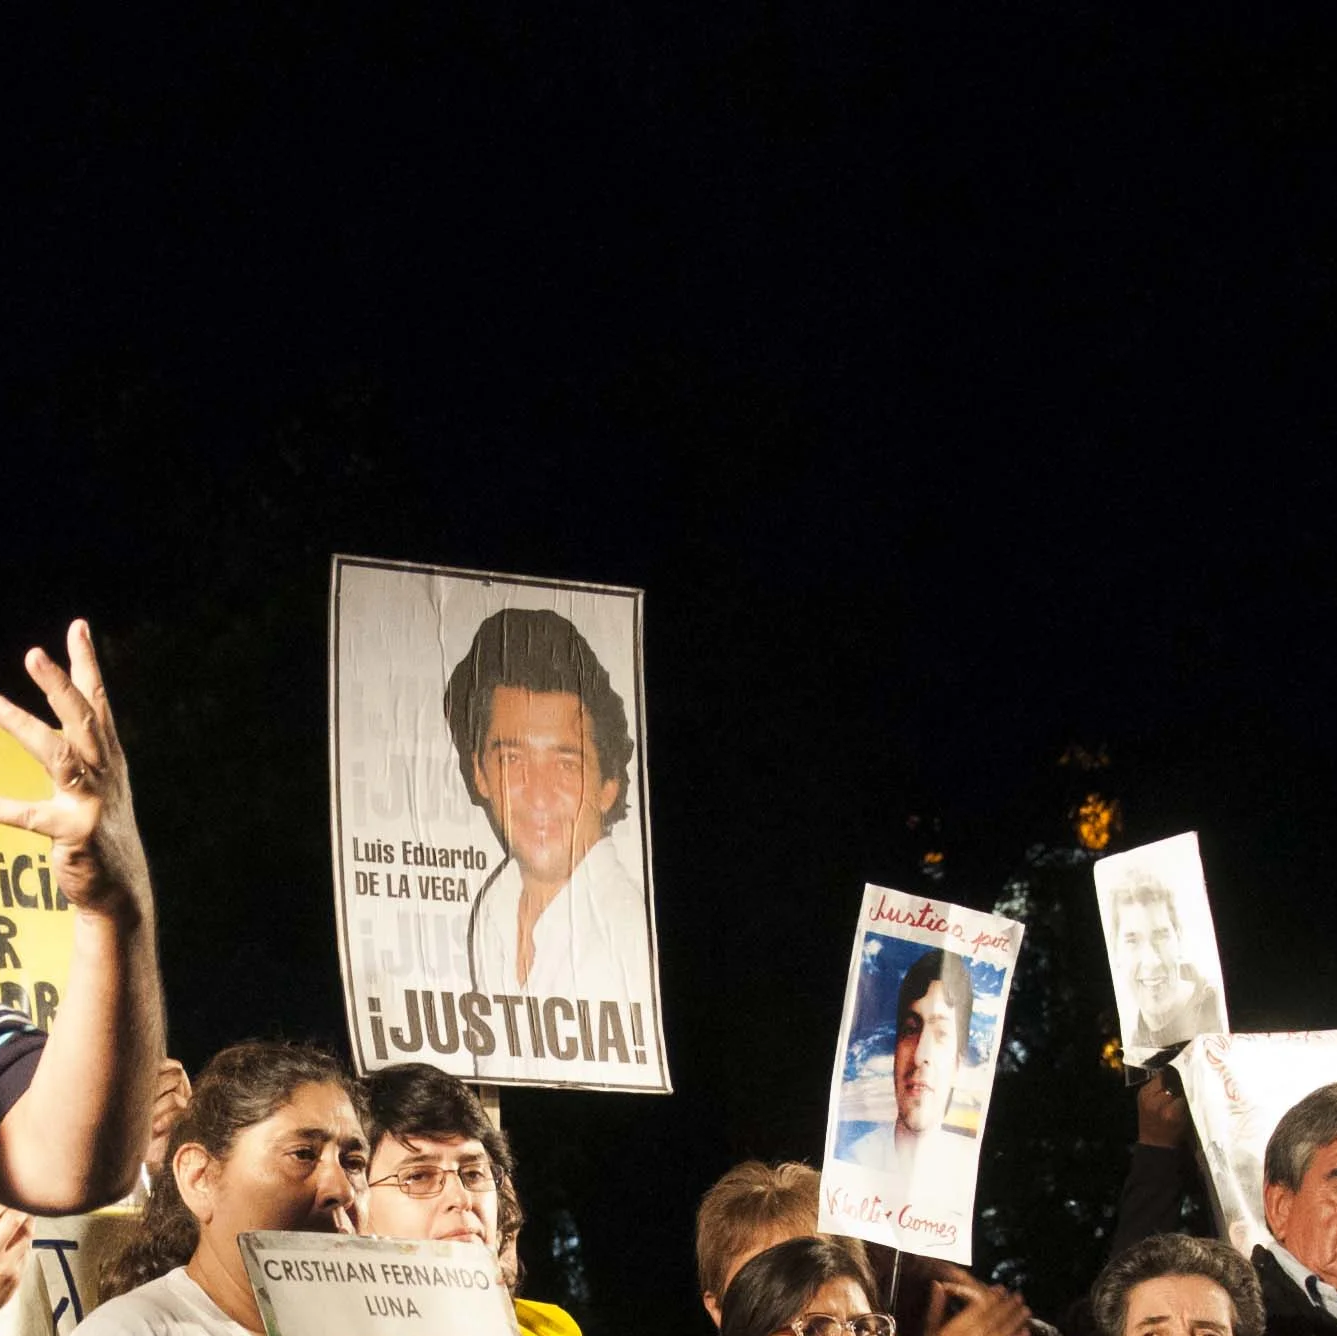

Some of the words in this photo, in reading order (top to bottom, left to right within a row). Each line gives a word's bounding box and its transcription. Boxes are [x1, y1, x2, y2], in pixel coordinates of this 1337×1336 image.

[352, 836, 396, 865] Luis
[401, 840, 489, 870] Eduardo
[354, 870, 381, 898] DE
[385, 874, 411, 900] LA
[416, 875, 470, 903] VEGA
[367, 988, 649, 1066] ¡JUSTICIA!
[264, 1257, 378, 1285] CRISTHIAN
[381, 1262, 491, 1293] FERNANDO
[363, 1294, 422, 1320] LUNA
